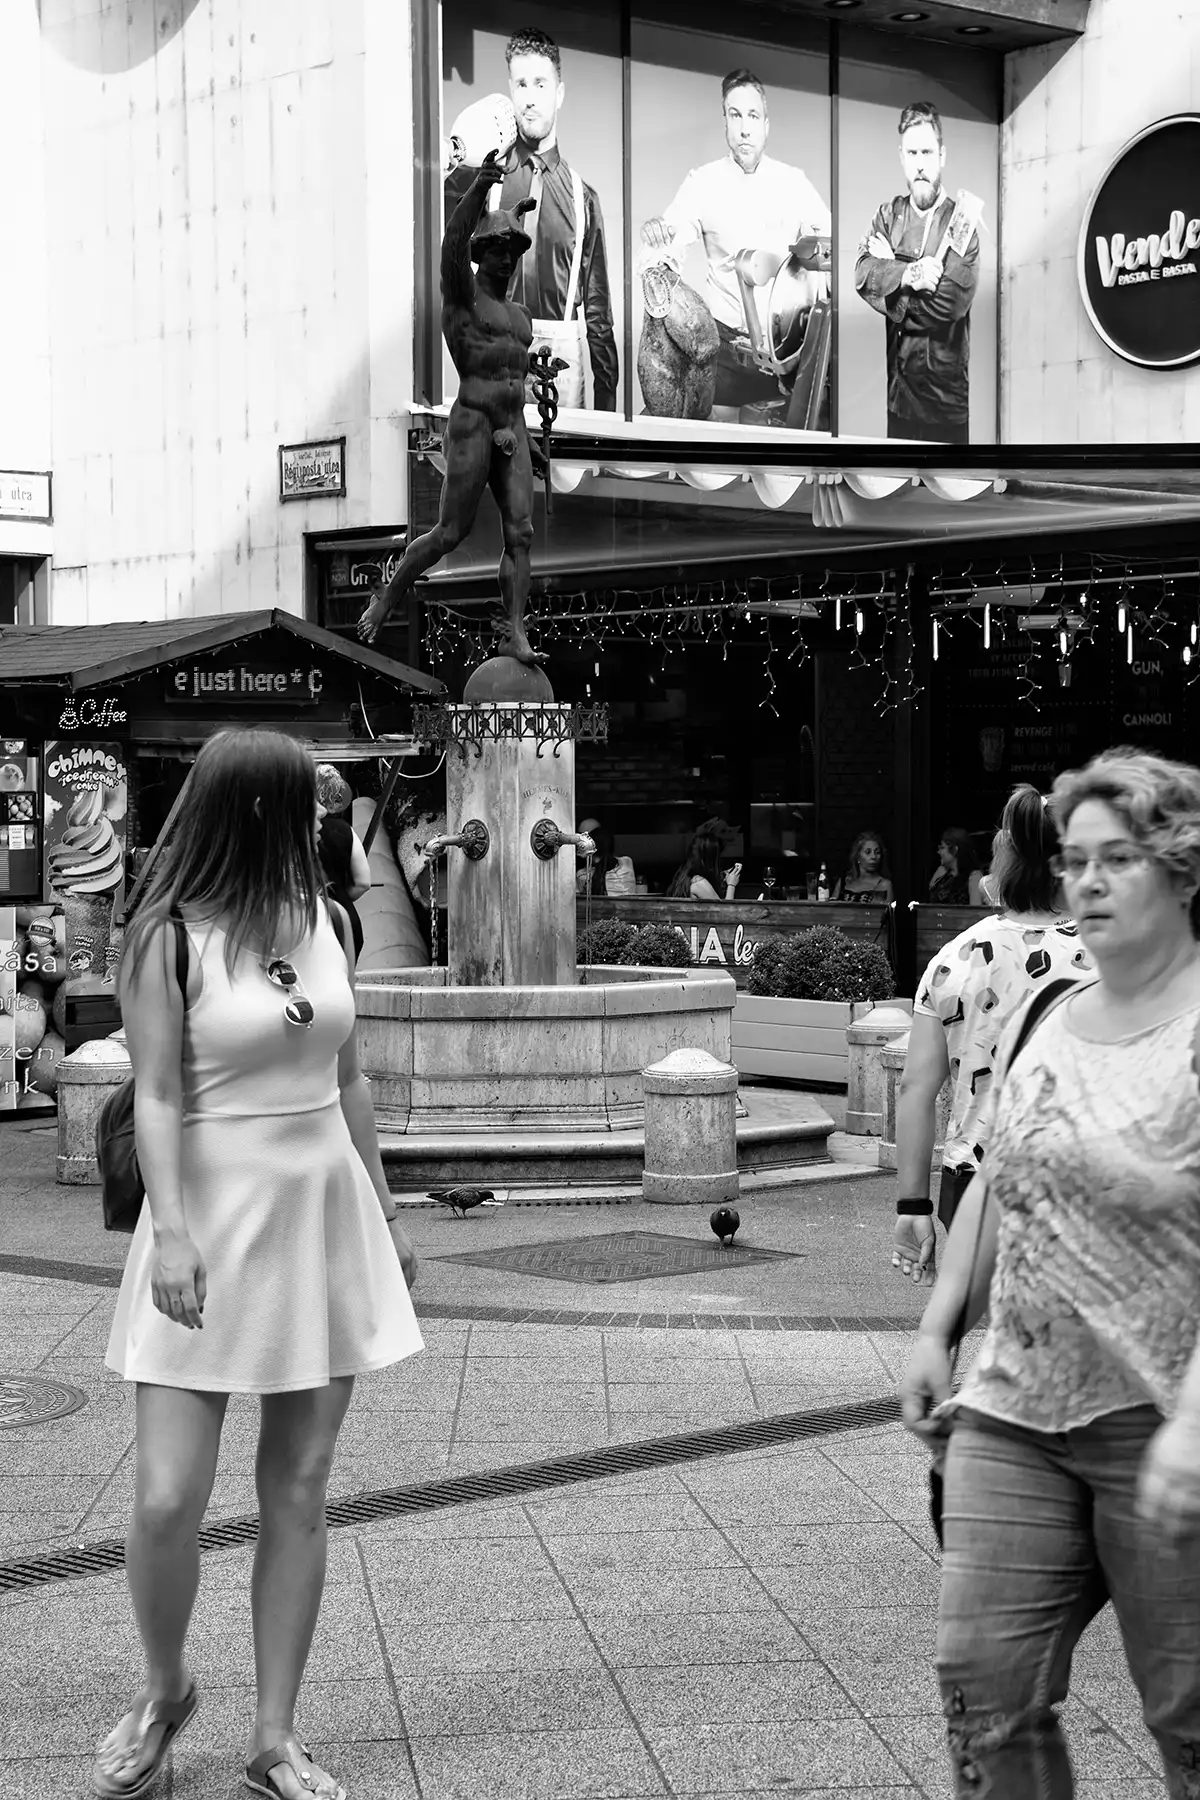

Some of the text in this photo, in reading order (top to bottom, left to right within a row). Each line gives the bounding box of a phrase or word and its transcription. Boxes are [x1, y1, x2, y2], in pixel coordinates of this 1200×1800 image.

[1095, 210, 1200, 288] Vende
[1118, 263, 1197, 285] PASTA E BASTA
[11, 486, 33, 501] utca
[1131, 660, 1164, 676] GUN,
[193, 667, 236, 696] just
[240, 667, 287, 692] here
[80, 698, 128, 727] Coffee
[1122, 712, 1172, 727] CANNOLI
[1014, 726, 1053, 738] REVENGE
[76, 781, 99, 792] cake
[0, 941, 57, 973] ása
